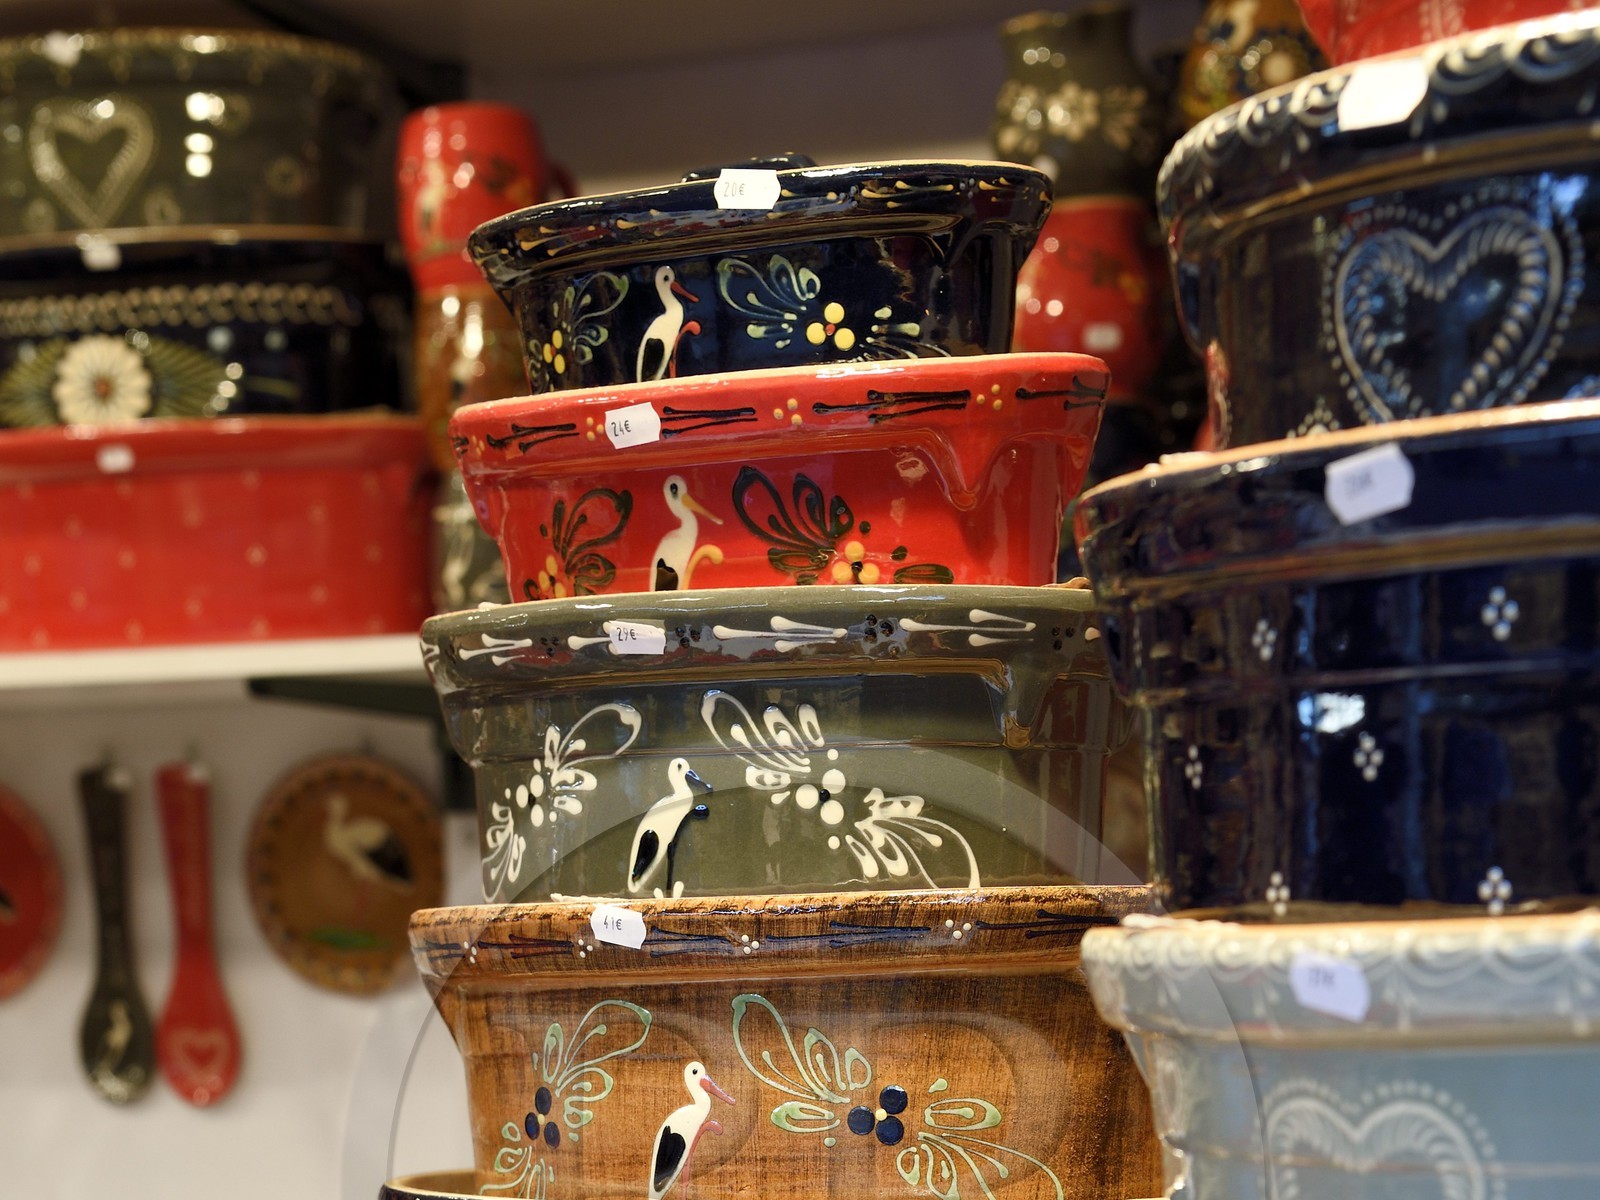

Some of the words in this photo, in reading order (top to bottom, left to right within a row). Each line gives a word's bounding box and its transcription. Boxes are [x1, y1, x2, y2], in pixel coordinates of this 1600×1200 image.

[723, 181, 746, 196] 20€
[610, 419, 632, 437] 24€
[616, 626, 637, 641] 29€
[603, 914, 623, 931] 41€
